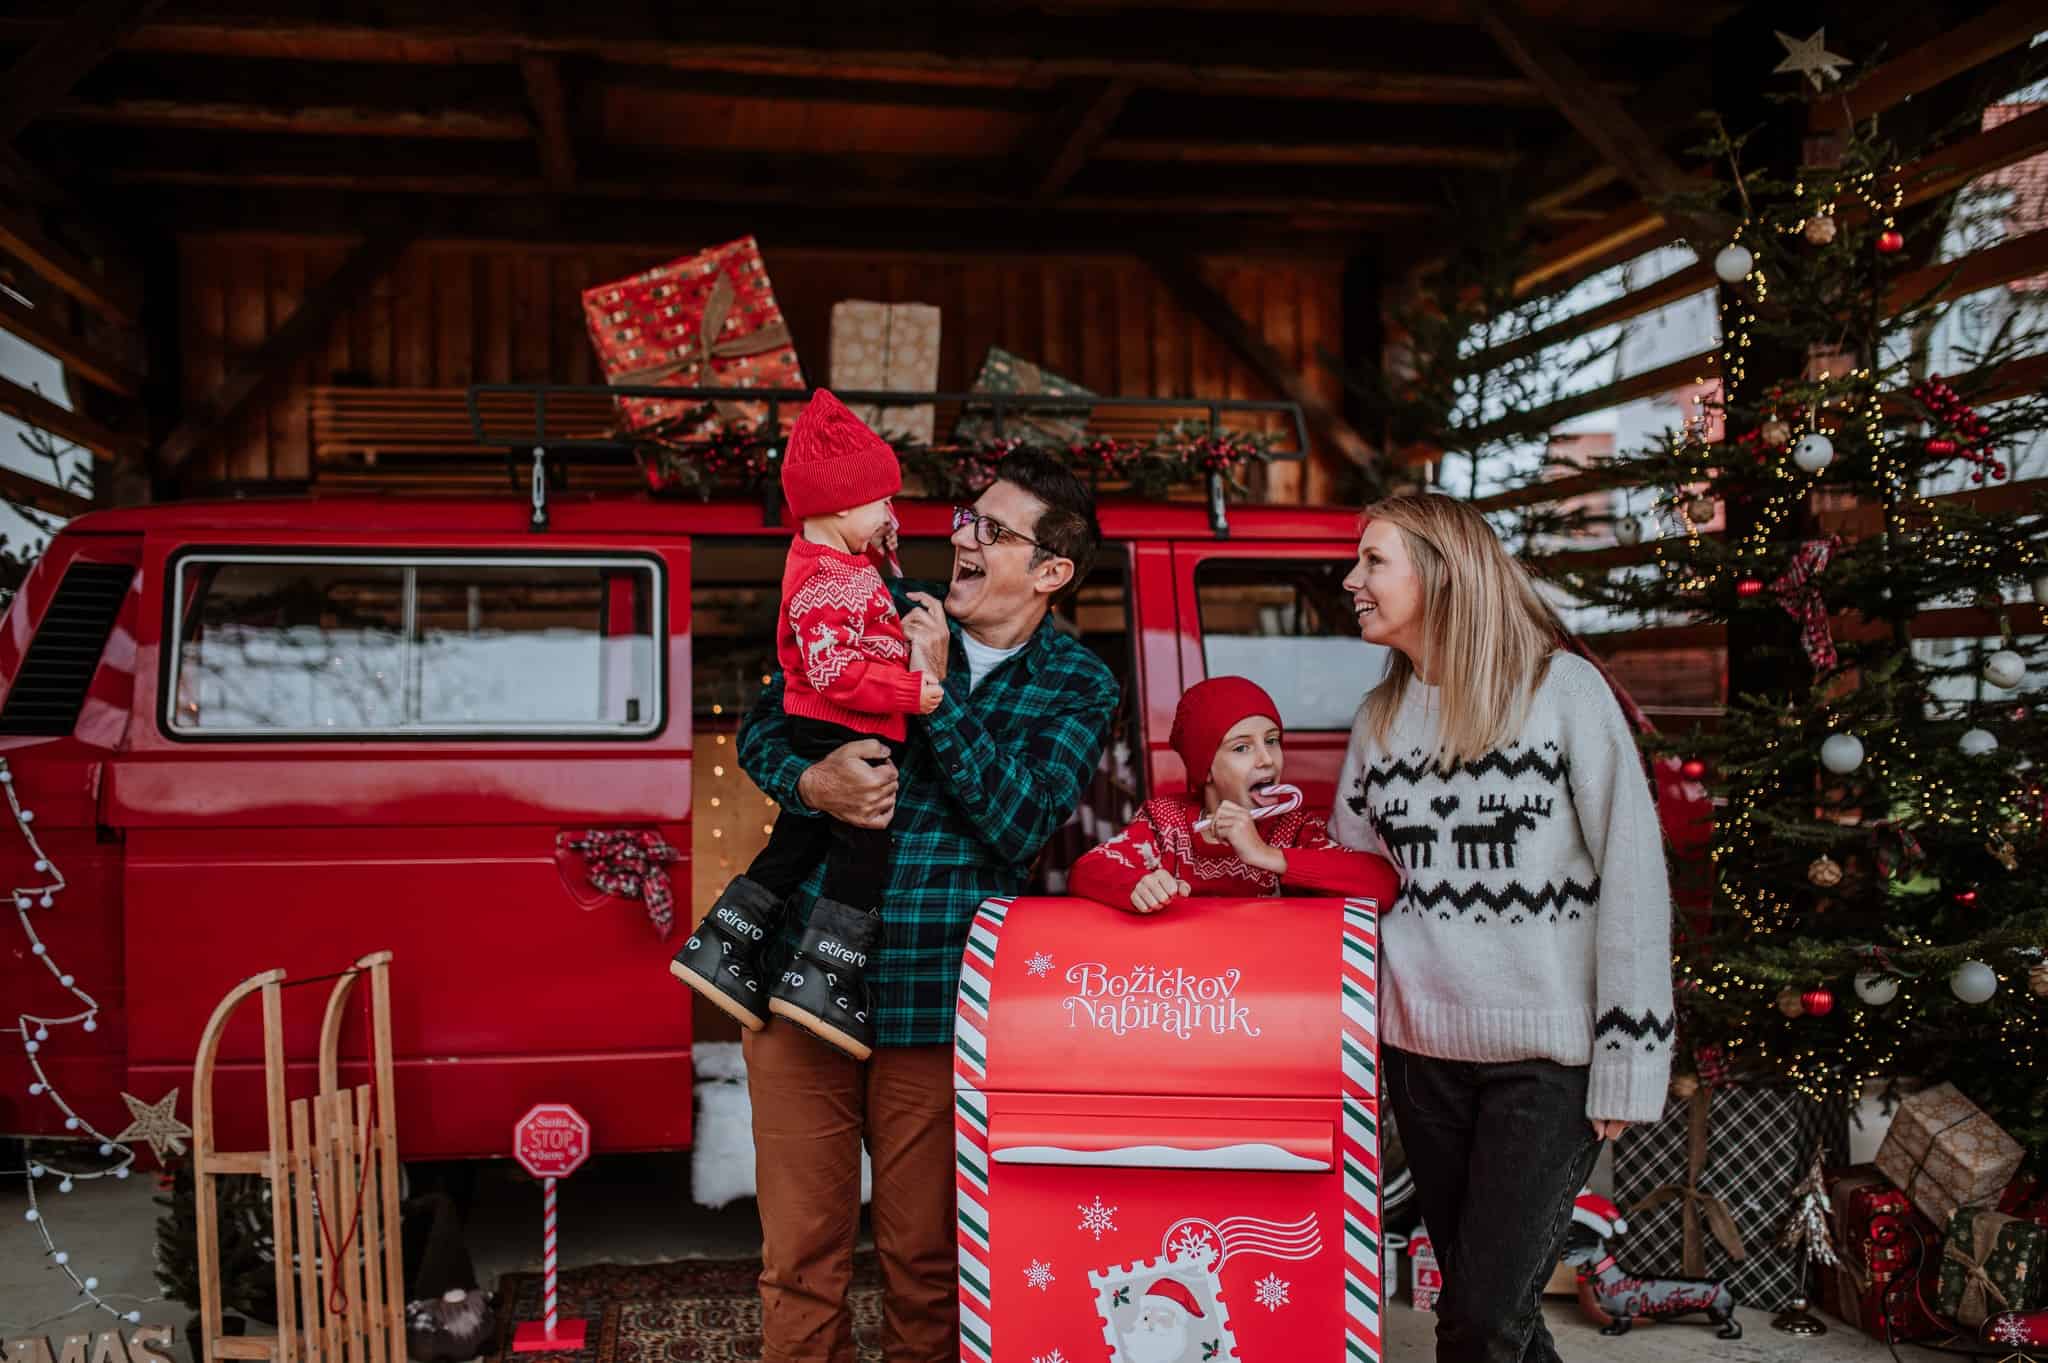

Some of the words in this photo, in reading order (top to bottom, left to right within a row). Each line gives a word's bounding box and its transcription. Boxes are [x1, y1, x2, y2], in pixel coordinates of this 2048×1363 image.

[716, 906, 764, 941] etirero
[818, 940, 867, 968] etirero
[1065, 962, 1241, 1003] Božičkov
[1062, 995, 1262, 1040] Nabiralnik
[529, 1129, 575, 1150] STOP
